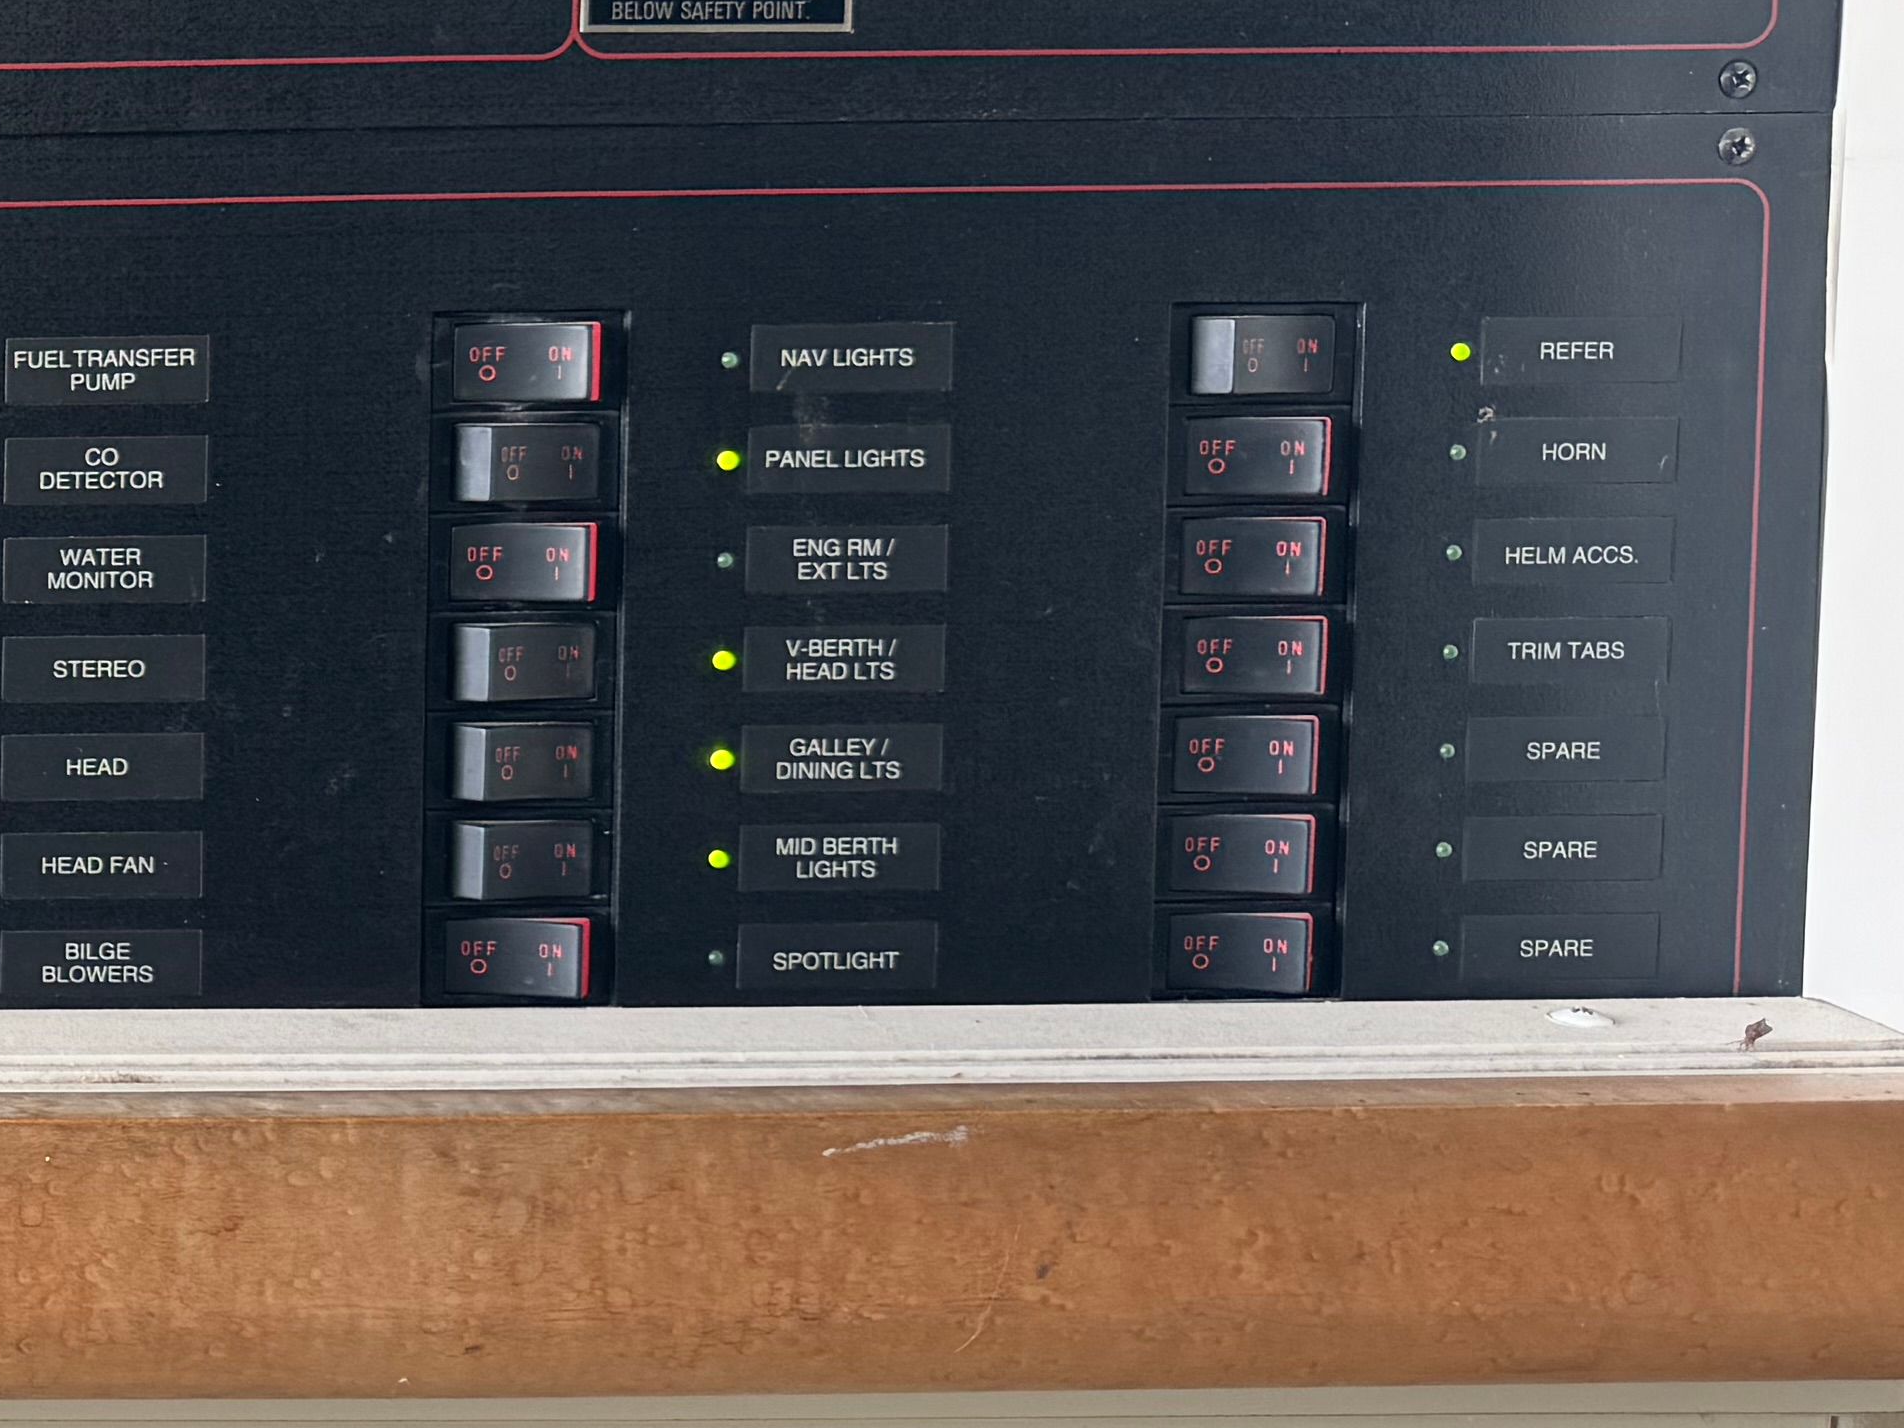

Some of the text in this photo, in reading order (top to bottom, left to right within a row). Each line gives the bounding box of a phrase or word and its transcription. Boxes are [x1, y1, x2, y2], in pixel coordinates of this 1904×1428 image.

[611, 0, 674, 20] BELOW
[680, 0, 746, 20] SAFETY
[13, 347, 195, 369] FUEL TRANSFER
[781, 347, 914, 367] NAV LIGHTS
[1540, 341, 1614, 360] REFER
[70, 372, 136, 392] PUMP
[84, 447, 120, 467] CO
[1199, 439, 1306, 456] OFF ON
[1542, 442, 1607, 461] HORN
[39, 470, 163, 490] DETECTOR
[1505, 545, 1639, 565] HELM ACCS.
[53, 659, 146, 679] STEREO
[775, 836, 898, 856] MID BERTH
[796, 859, 876, 879] LIGHTS
[65, 942, 131, 961] BILGE
[773, 951, 900, 971] SPOTLIGHT
[42, 964, 154, 983] BLOWERS
